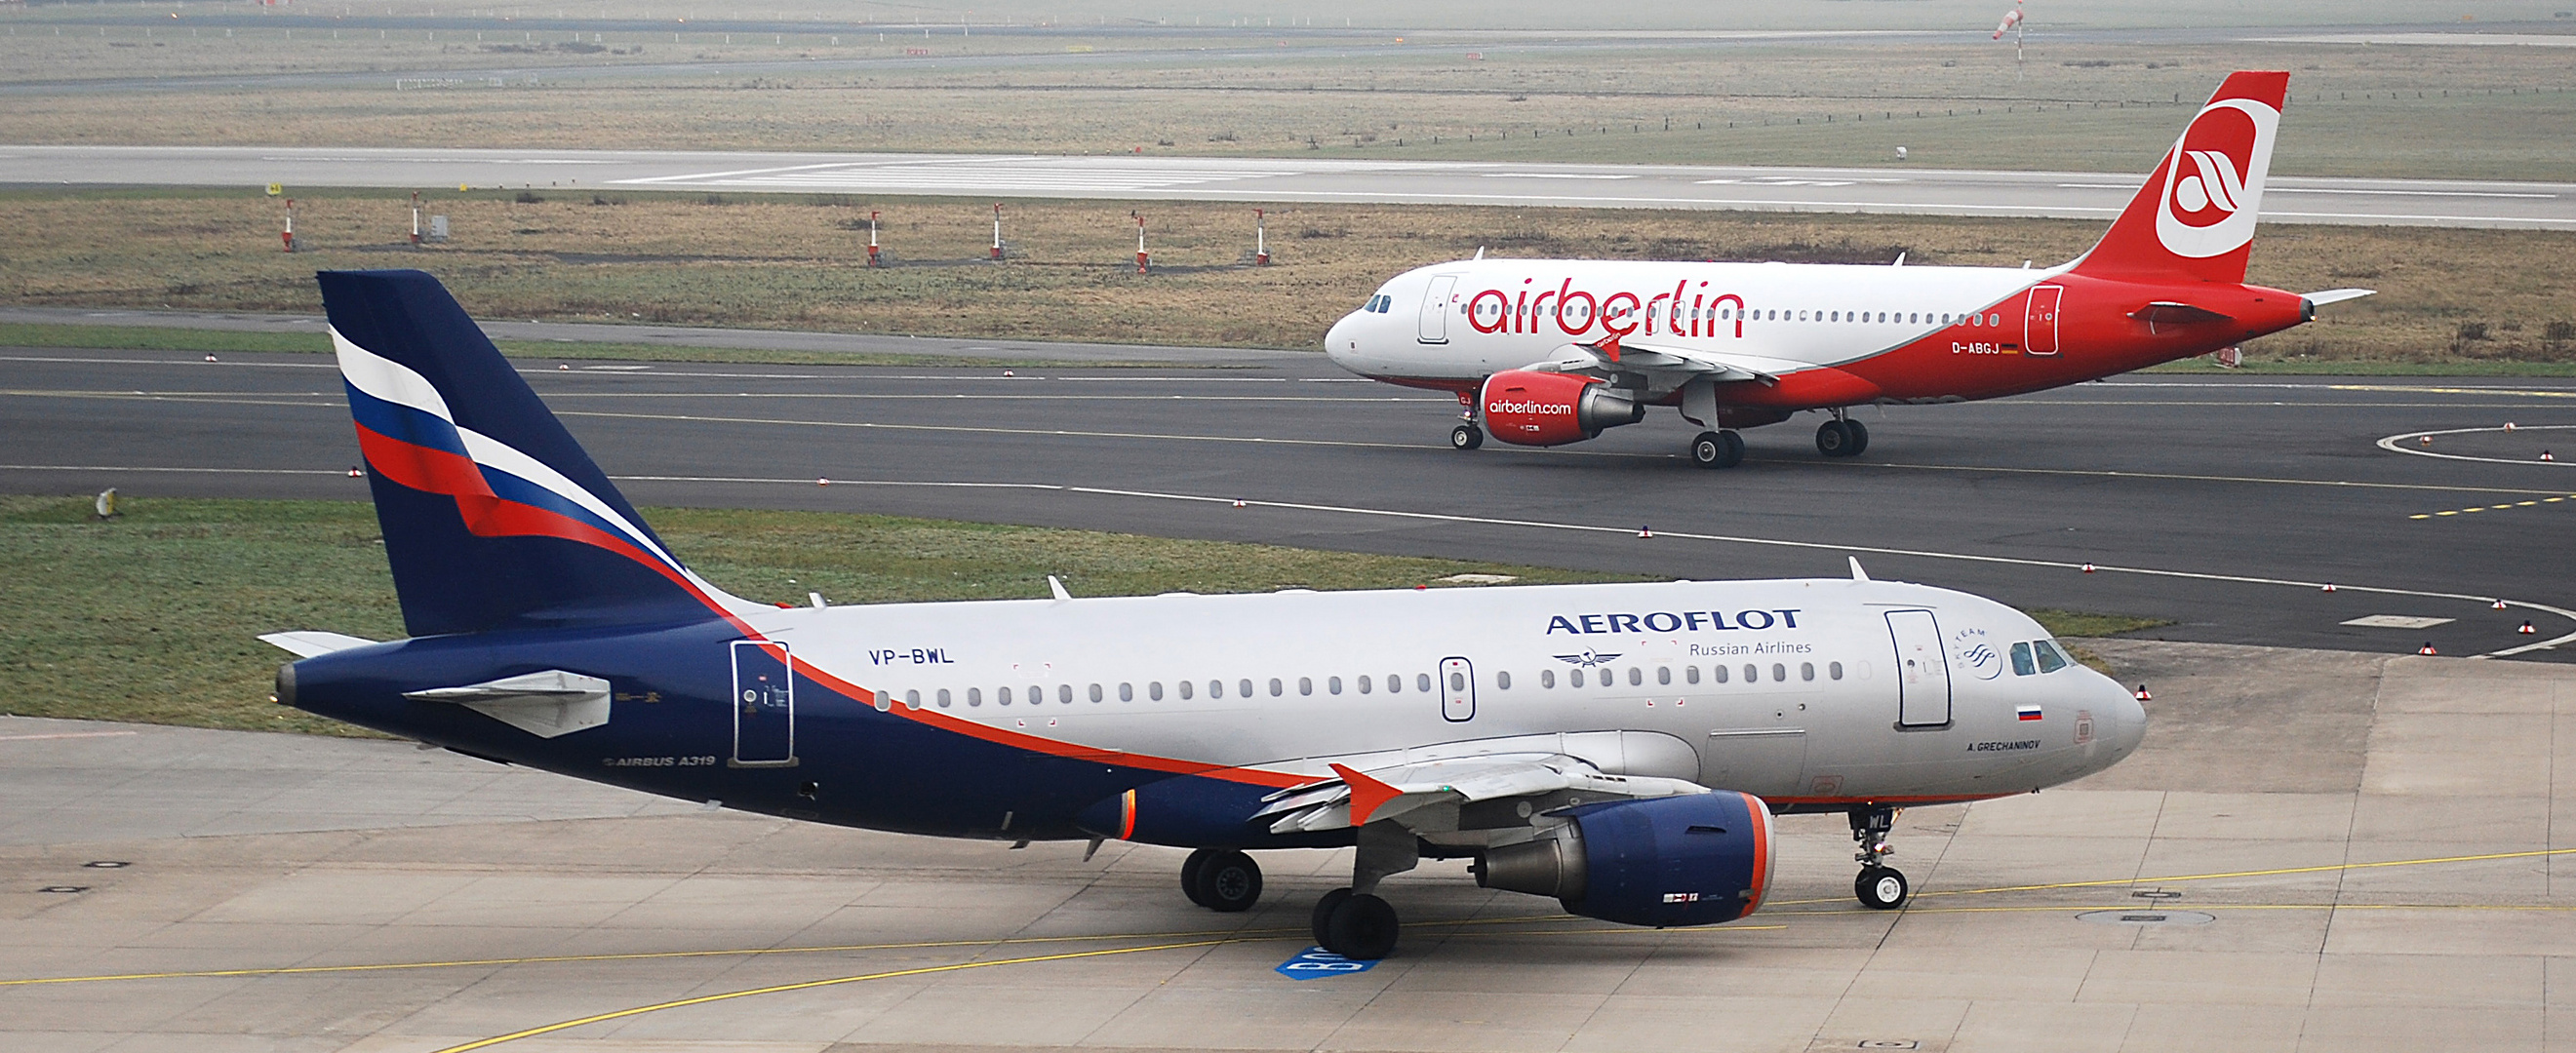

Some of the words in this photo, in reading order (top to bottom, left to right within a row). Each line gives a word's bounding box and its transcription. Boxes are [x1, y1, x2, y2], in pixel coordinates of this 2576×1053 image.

[1467, 277, 1745, 338] airberlin
[1952, 341, 2000, 354] D-ABGJ
[1489, 400, 1571, 415] airberlin.com
[1546, 609, 1802, 635] AEROFLOT
[1689, 644, 1749, 656] Russian
[1754, 641, 1811, 654] Airlines
[868, 648, 955, 665] VP-BWL
[615, 757, 675, 766] AIRBUS
[678, 756, 716, 766] A319
[1870, 815, 1889, 829] WL
